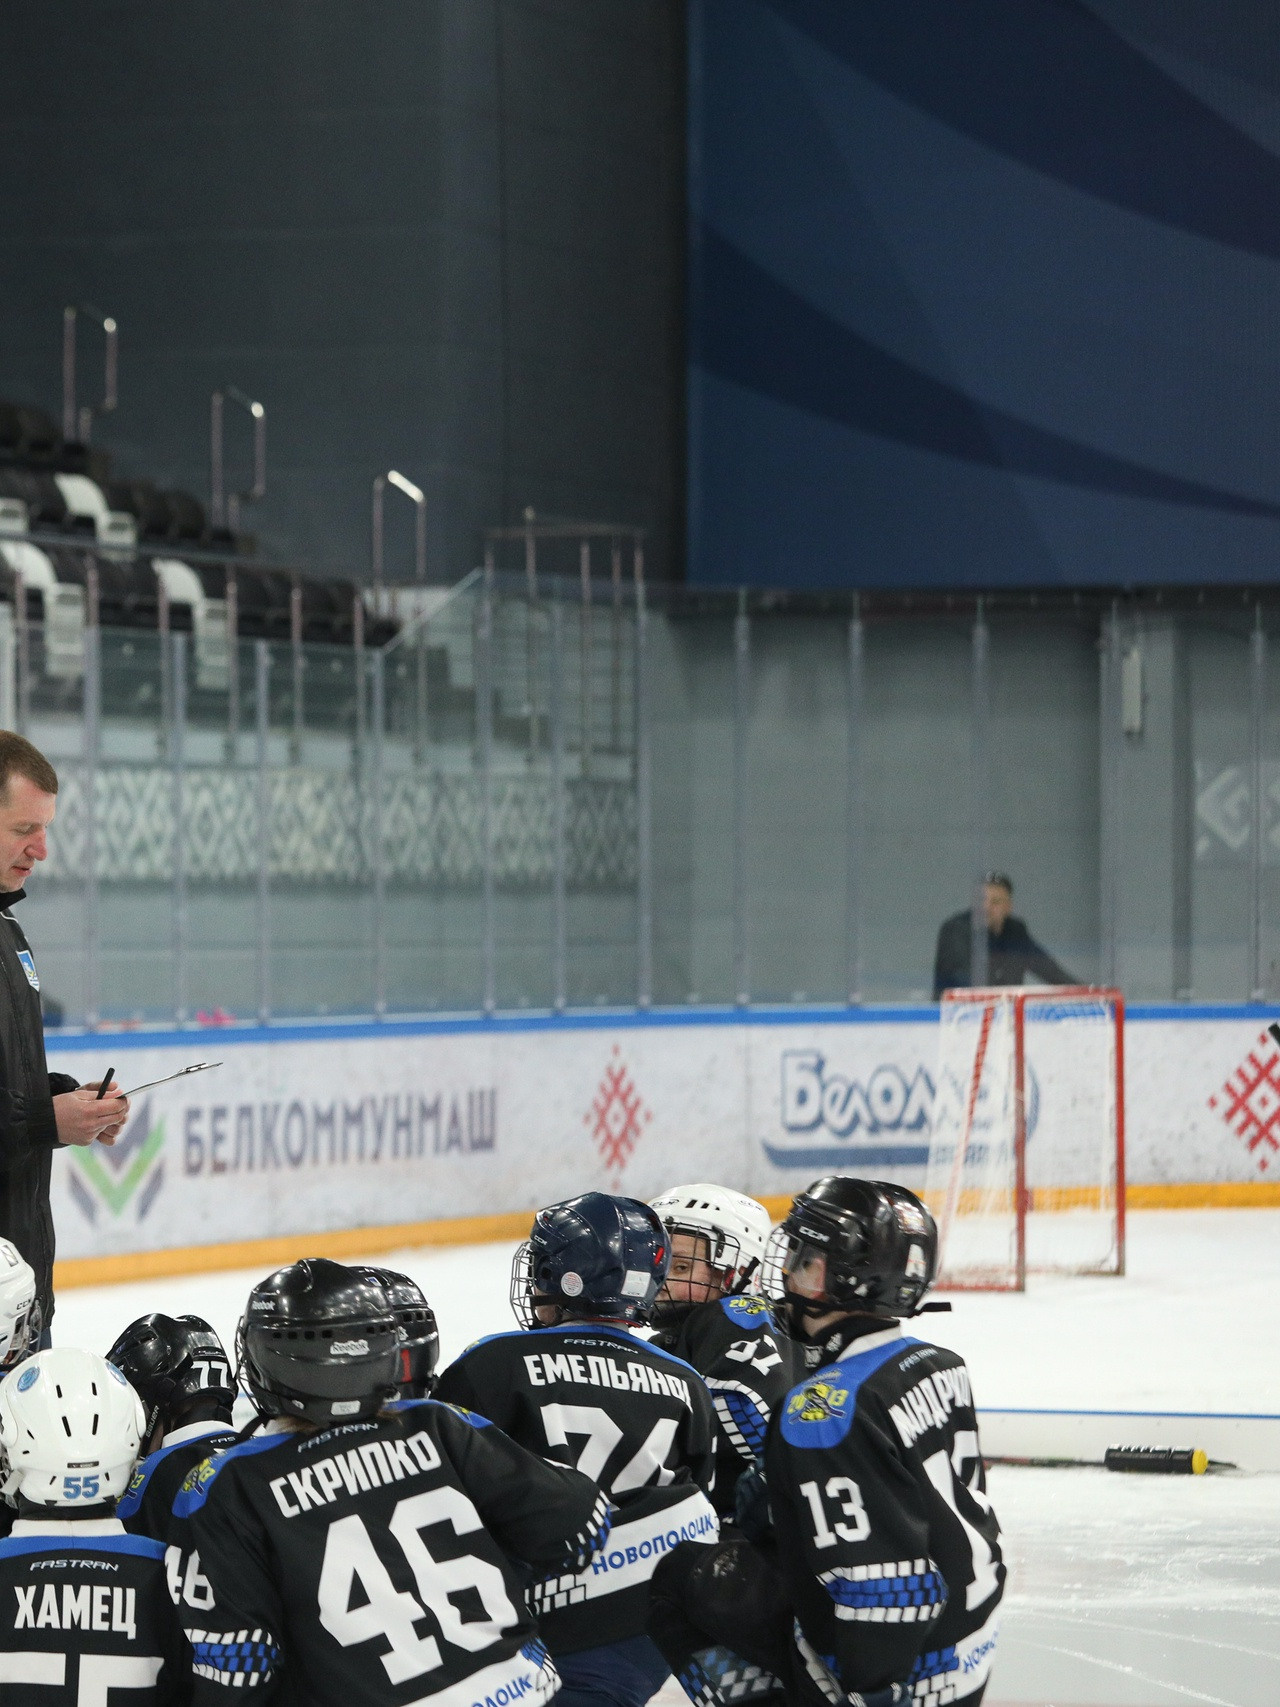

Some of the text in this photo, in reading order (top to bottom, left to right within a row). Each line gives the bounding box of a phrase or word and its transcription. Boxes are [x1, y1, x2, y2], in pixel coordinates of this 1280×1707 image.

[183, 1088, 497, 1176] БЕЛКОММУНМАШ
[332, 1340, 368, 1355] Reebok
[563, 1338, 639, 1354] FASTRAN
[191, 1360, 228, 1390] 77
[144, 1405, 160, 1439] BAUER
[297, 1422, 379, 1453] FASTRAN
[210, 1436, 236, 1444] FAS
[62, 1475, 100, 1500] 55
[269, 1430, 442, 1519] СКРИПКО
[799, 1476, 872, 1550] 13
[592, 1513, 715, 1576] НОВОПОЛОЦК
[29, 1560, 119, 1573] FASTRAN
[317, 1485, 518, 1686] 46
[13, 1584, 136, 1641] ХАМЕЦ
